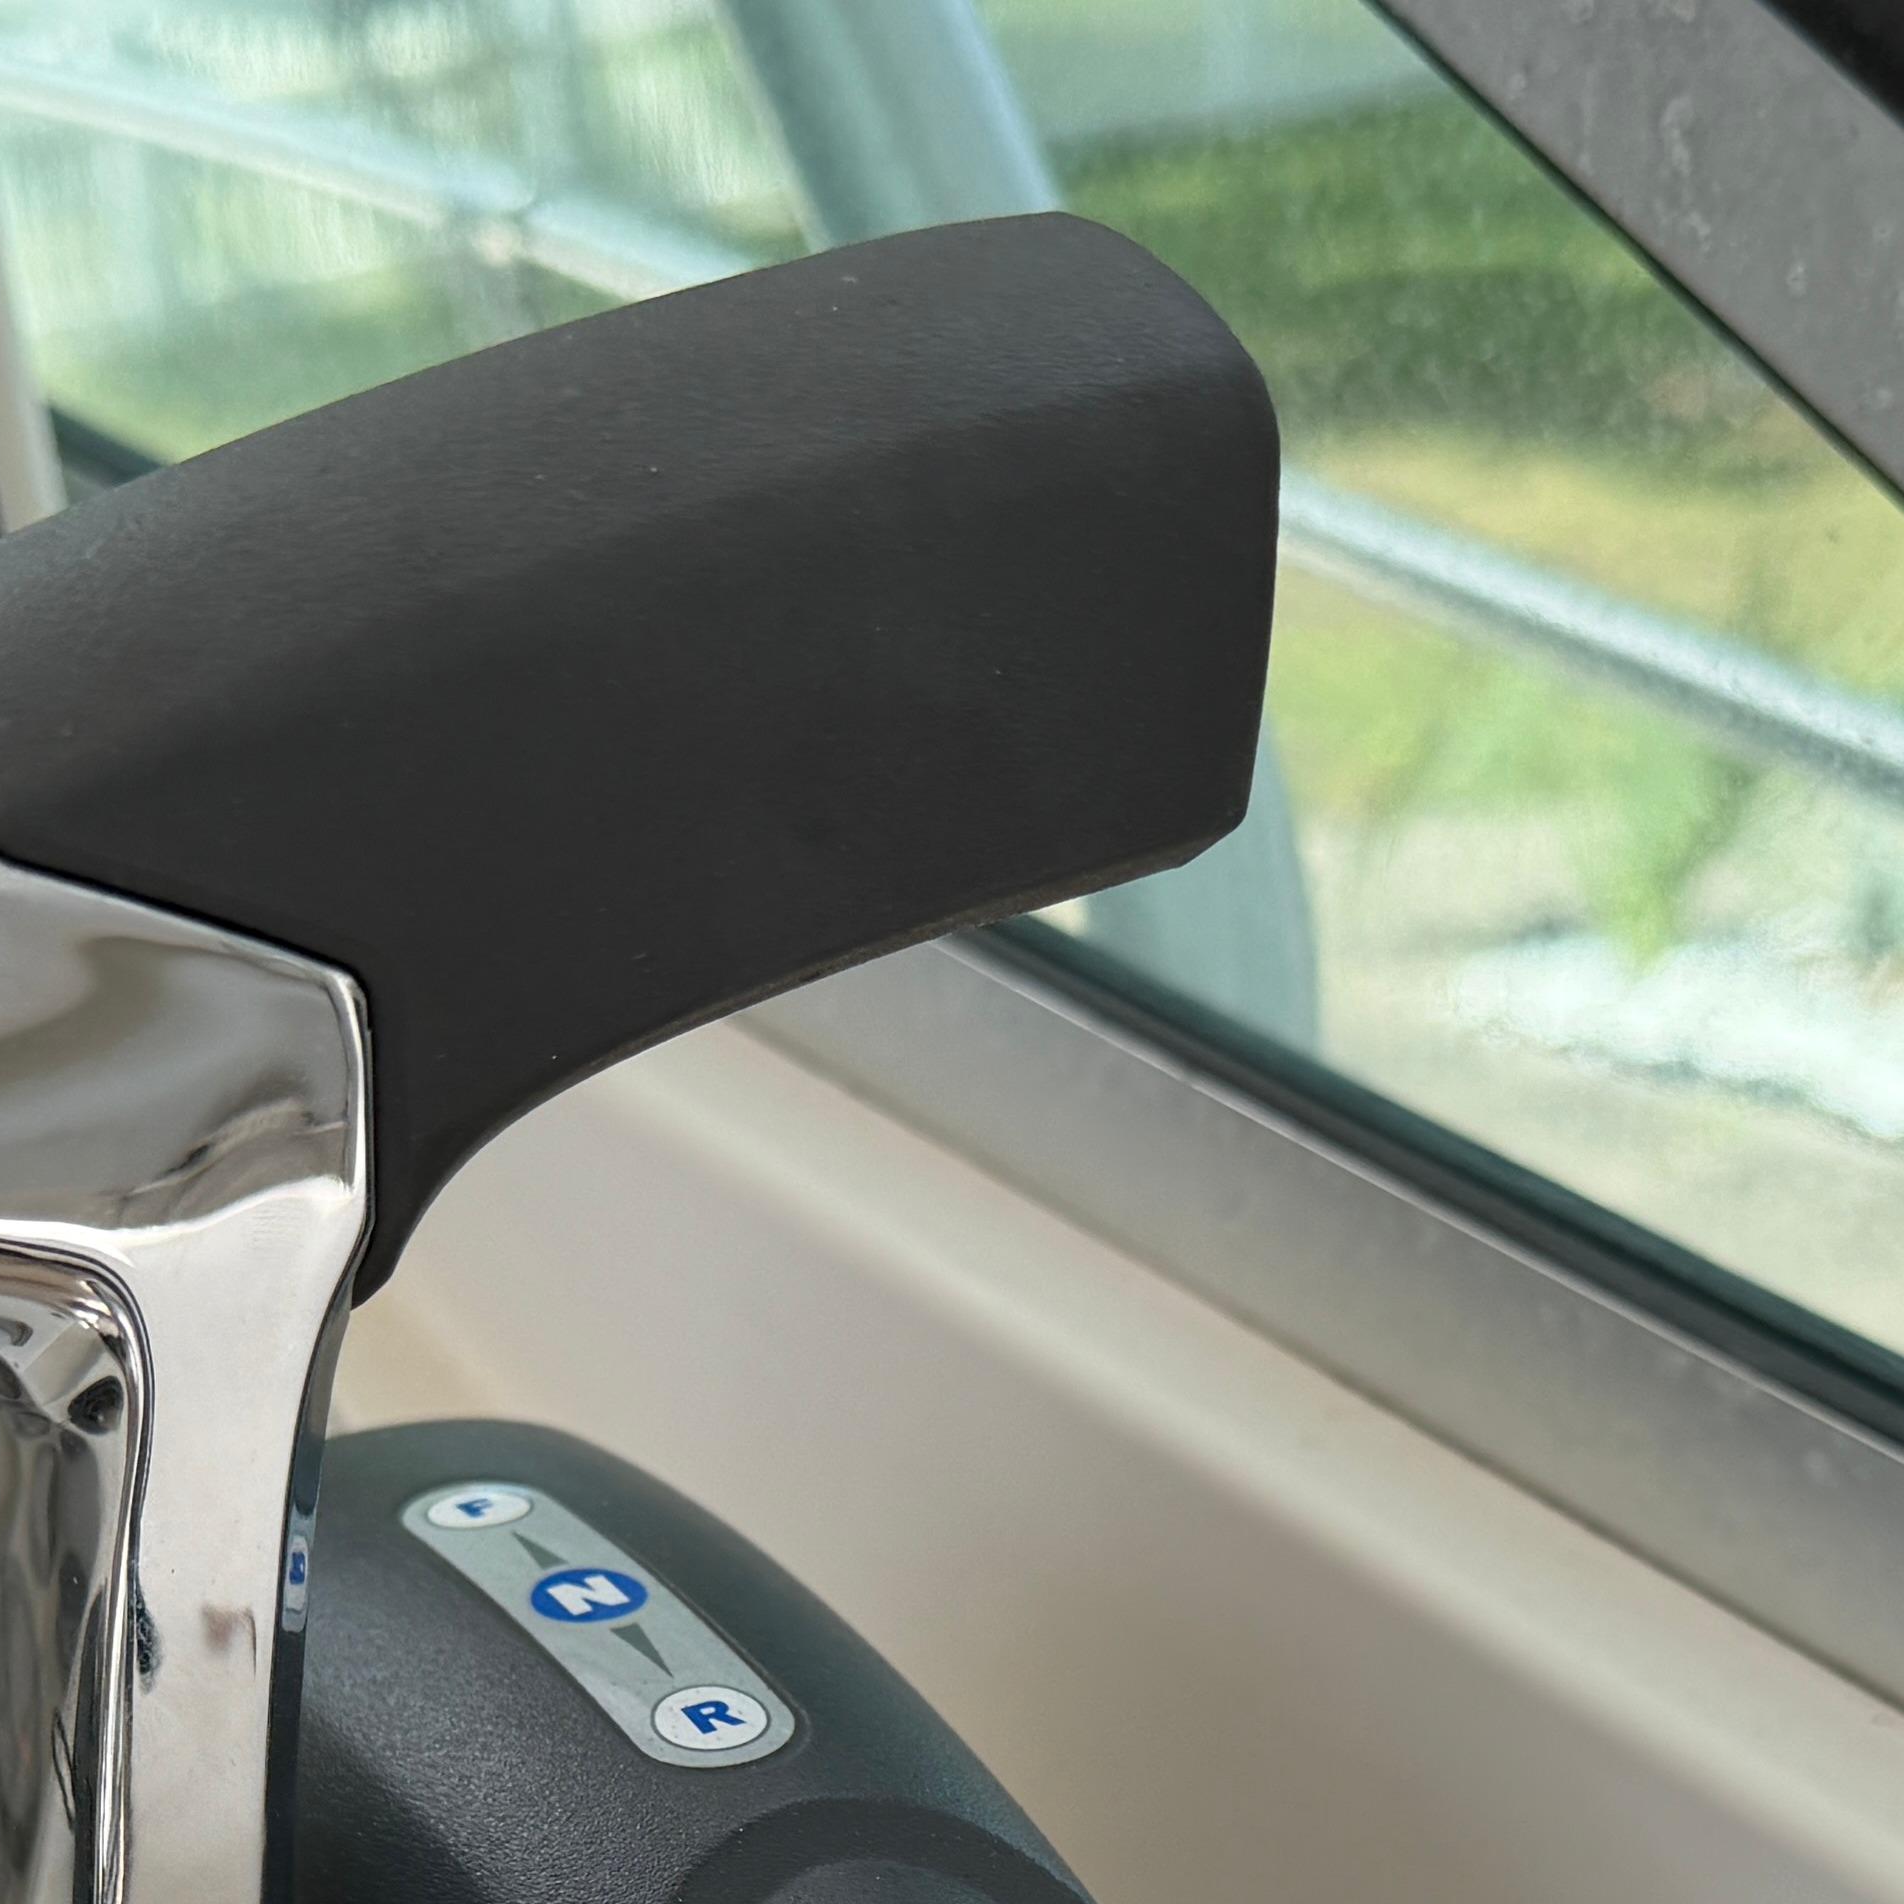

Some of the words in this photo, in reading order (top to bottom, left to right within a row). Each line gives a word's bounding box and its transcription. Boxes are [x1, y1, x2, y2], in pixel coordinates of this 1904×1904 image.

[456, 1498, 493, 1518] F
[546, 1574, 632, 1617] N
[680, 1700, 746, 1735] R
